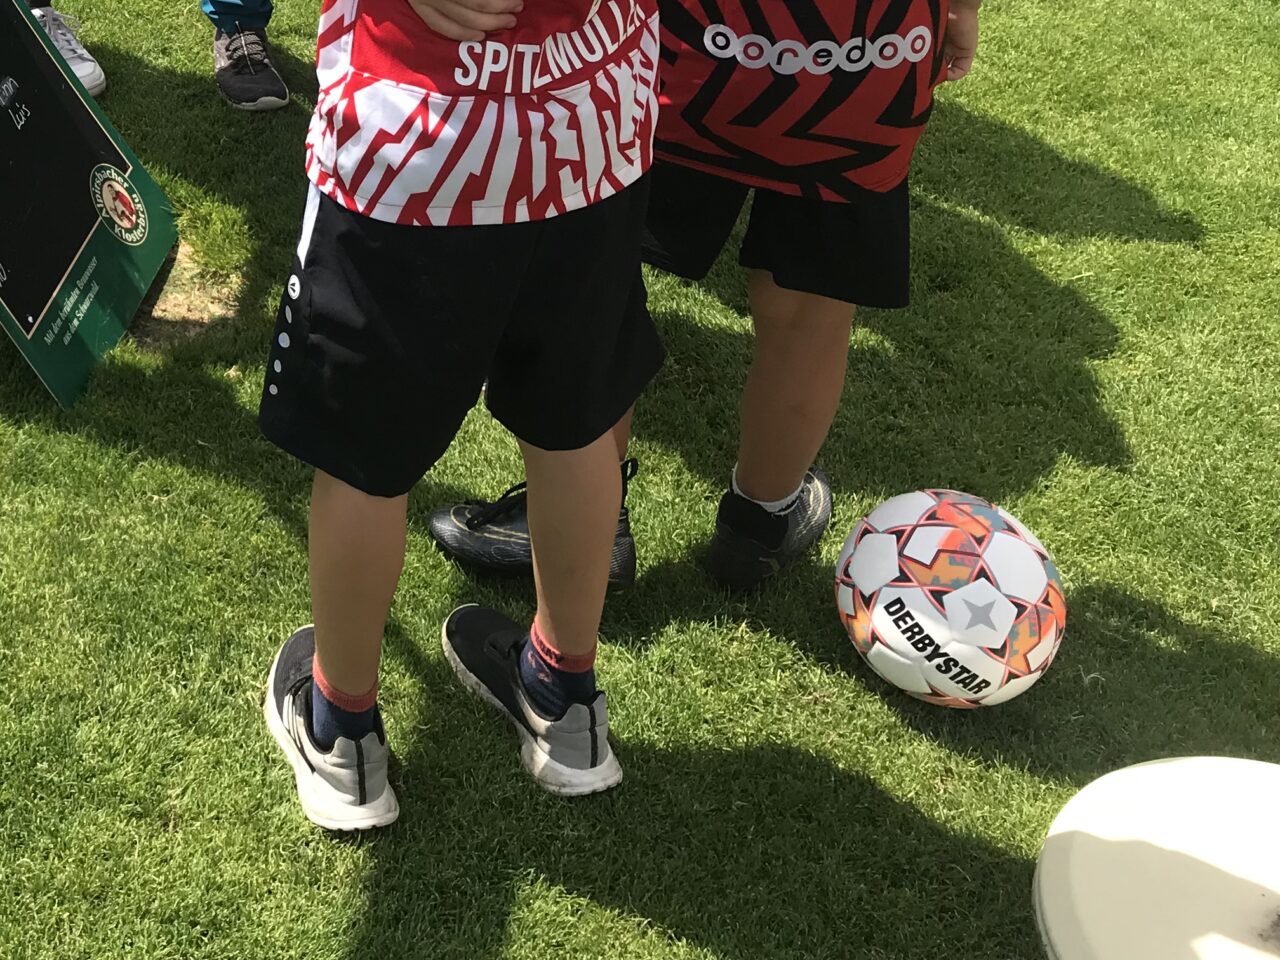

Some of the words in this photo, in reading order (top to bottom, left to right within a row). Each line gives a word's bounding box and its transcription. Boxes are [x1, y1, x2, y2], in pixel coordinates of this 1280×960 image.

[704, 24, 933, 75] ooredoo
[8, 102, 31, 130] Luis
[92, 168, 129, 218] Alpirsbacher
[114, 193, 146, 242] Klosterbräu
[883, 596, 991, 695] DERBYSTAR
